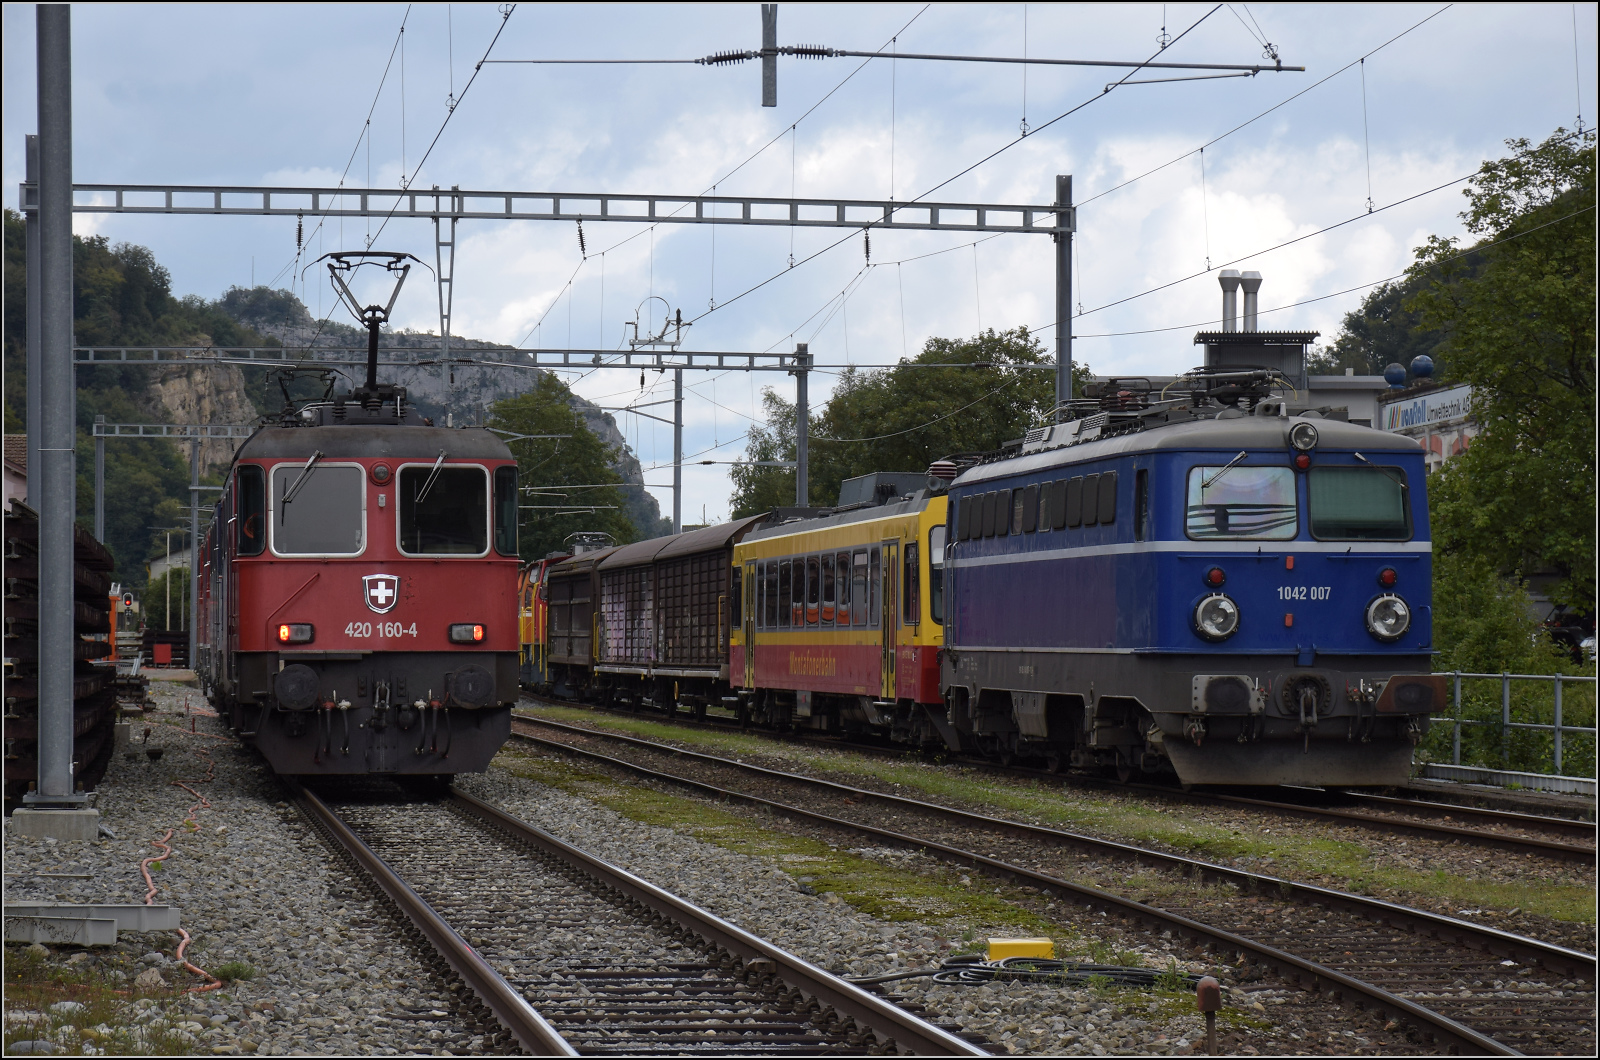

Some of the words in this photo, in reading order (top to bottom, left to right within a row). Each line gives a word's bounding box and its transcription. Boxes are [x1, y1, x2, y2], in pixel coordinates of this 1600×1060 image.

[1427, 399, 1461, 421] Umwelttechnik
[1462, 394, 1470, 414] AG
[1277, 586, 1307, 600] 1042
[1310, 586, 1331, 600] 007
[345, 622, 372, 638] 420
[376, 622, 418, 638] 160-4
[789, 649, 836, 677] Montafonerbahn
